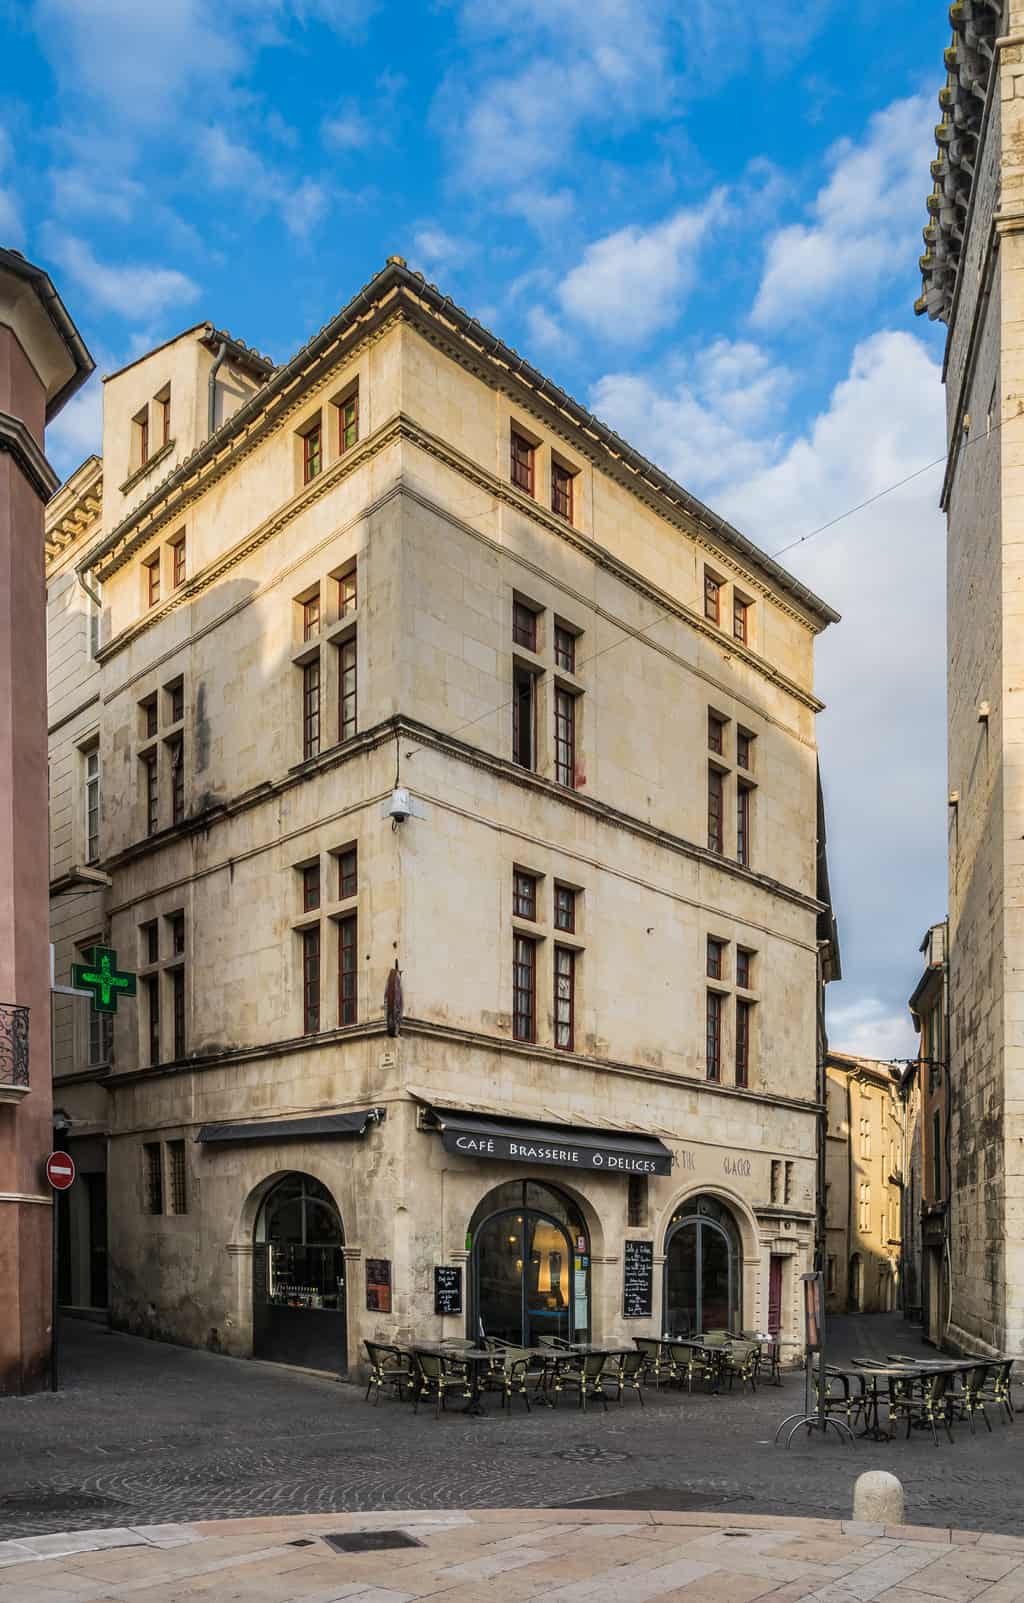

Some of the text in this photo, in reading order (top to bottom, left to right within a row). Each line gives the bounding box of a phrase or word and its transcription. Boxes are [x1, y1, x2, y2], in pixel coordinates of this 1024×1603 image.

[455, 1136, 495, 1153] CAFÉ
[509, 1143, 580, 1162] BRASSERIE
[607, 1156, 657, 1172] DELICES
